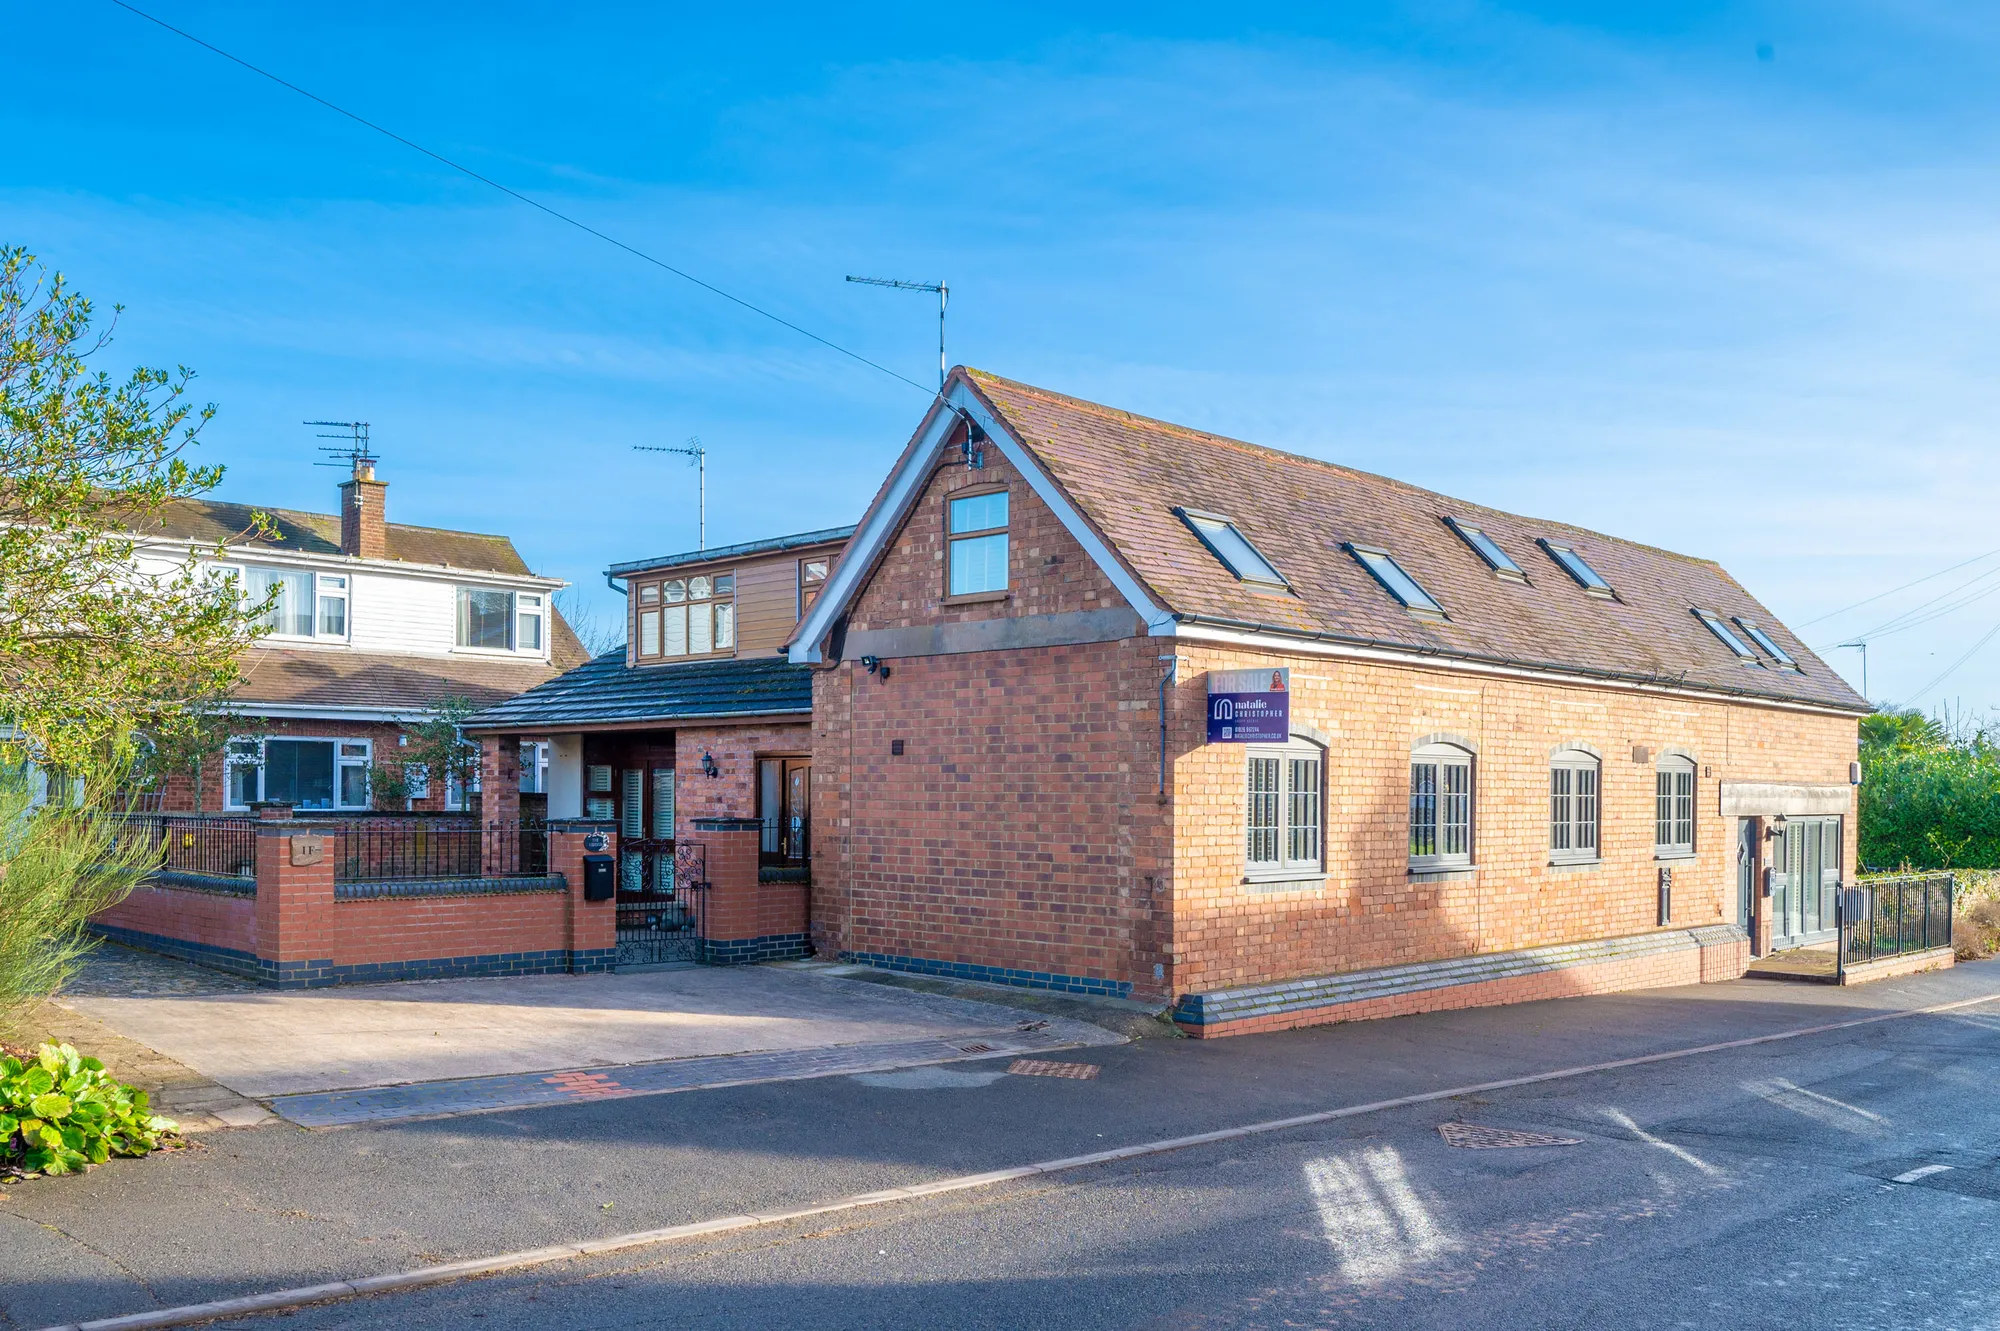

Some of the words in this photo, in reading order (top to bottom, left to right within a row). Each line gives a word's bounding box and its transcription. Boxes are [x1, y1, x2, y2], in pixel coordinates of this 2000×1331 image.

[1214, 674, 1236, 692] FOR
[1238, 673, 1267, 692] SALE
[1235, 699, 1267, 709] natalie
